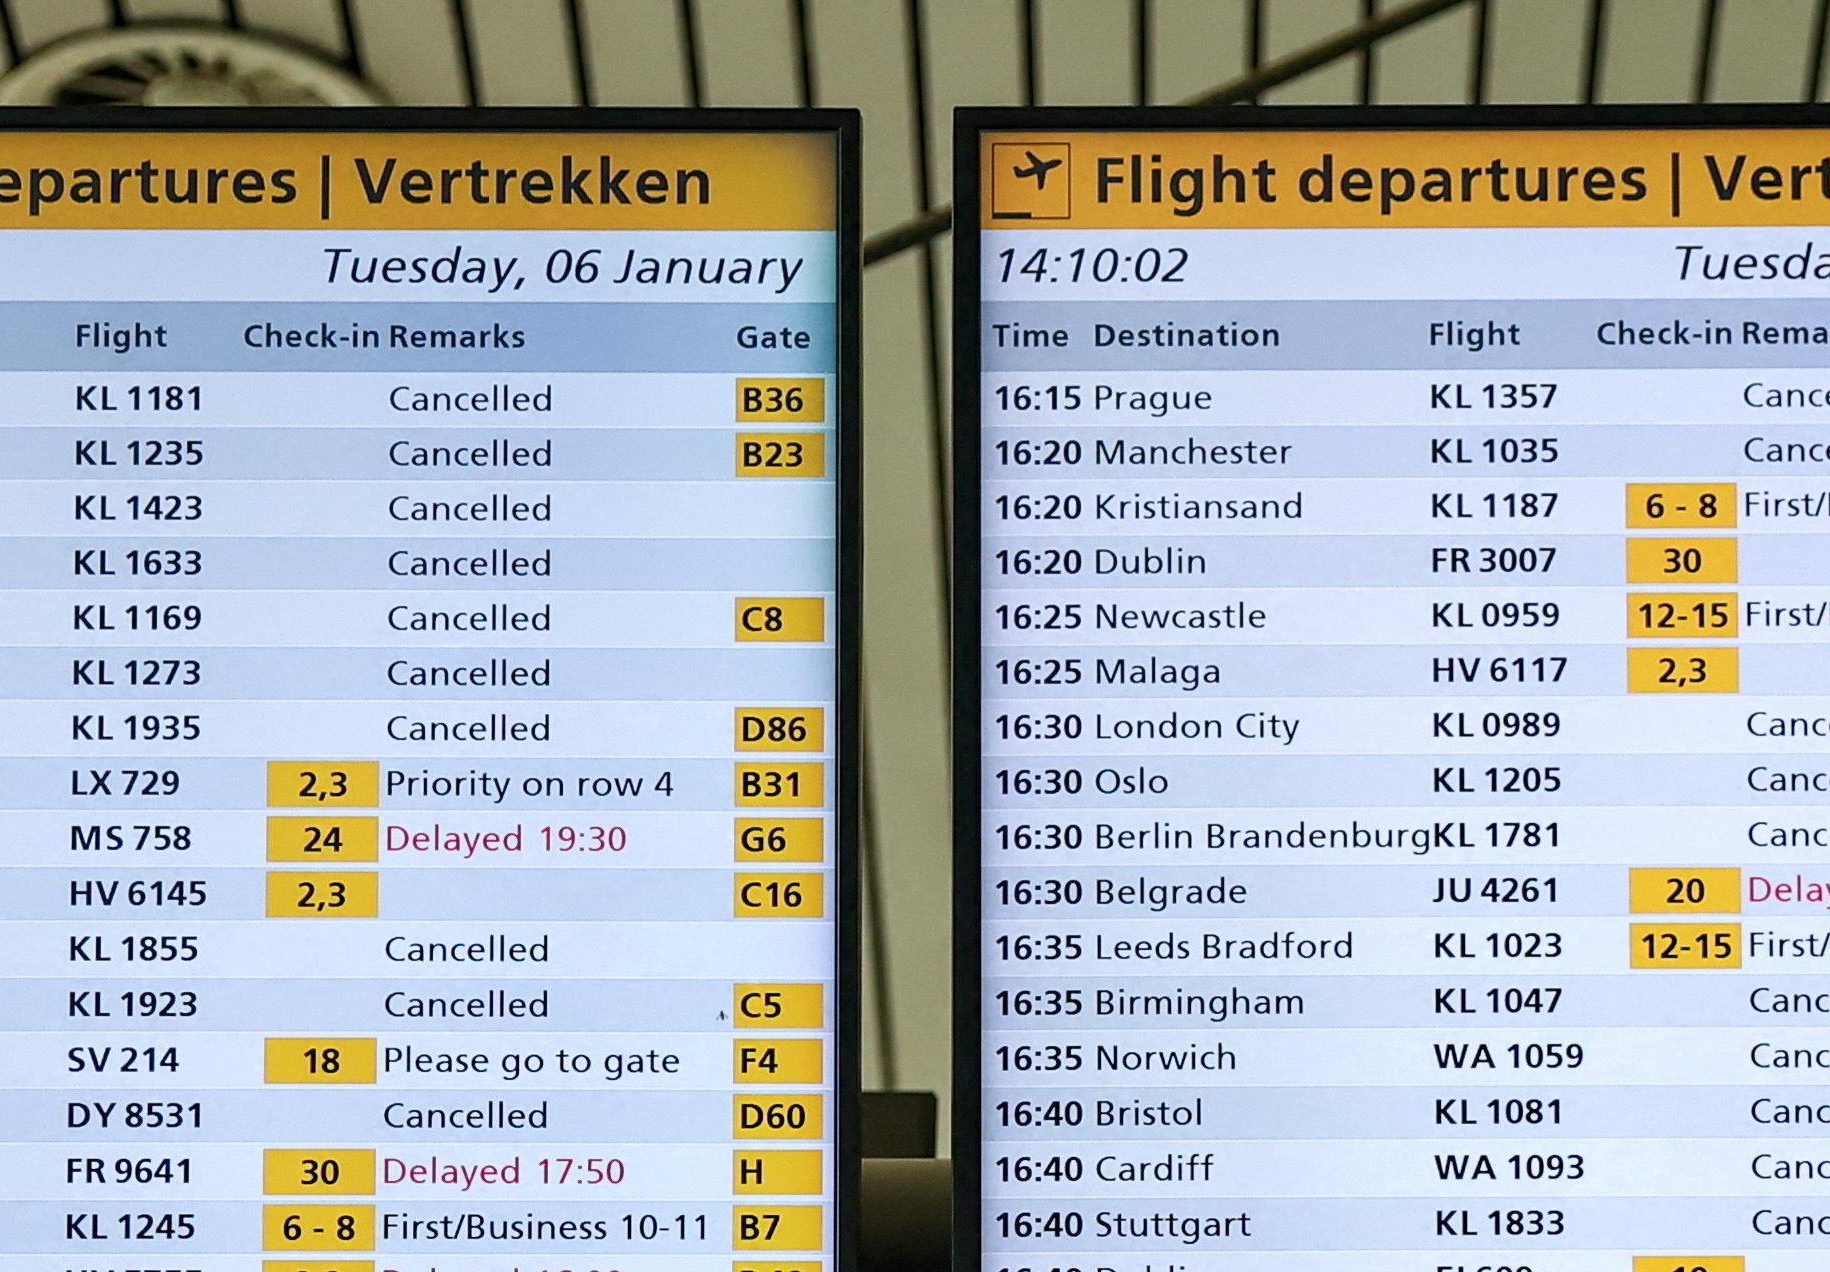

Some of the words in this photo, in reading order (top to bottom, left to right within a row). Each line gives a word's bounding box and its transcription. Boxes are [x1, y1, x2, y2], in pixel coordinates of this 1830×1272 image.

[352, 153, 711, 206] Vertrekken
[1096, 152, 1278, 219] Flight
[1297, 152, 1649, 217] departures
[322, 244, 527, 295] Tuesday,
[544, 247, 603, 286] 06
[611, 247, 805, 296] January
[998, 246, 1190, 284] 14:10:02
[75, 384, 119, 412] KL
[126, 384, 202, 412] 1181
[388, 382, 553, 413] Cancelled
[742, 385, 805, 415] B36
[994, 383, 1083, 412] 16:15
[1093, 383, 1213, 419] Prague
[1429, 382, 1474, 411] KL
[1480, 382, 1559, 410] 1357
[70, 768, 114, 797] LX
[119, 768, 181, 797] 729
[297, 770, 349, 803] 2,3
[385, 768, 512, 806] Priority
[521, 776, 566, 798] on
[577, 776, 645, 798] row
[652, 769, 675, 798] 4
[741, 770, 800, 799] B31
[66, 1045, 113, 1074] SV
[118, 1045, 181, 1074] 214
[302, 1046, 342, 1076] 18
[383, 1043, 491, 1074] Please
[500, 1052, 546, 1082] go
[554, 1048, 593, 1075] to
[602, 1048, 681, 1083] gate
[739, 1046, 780, 1075] F4
[994, 1043, 1084, 1073] 16:35
[1095, 1040, 1237, 1072] Norwich
[1432, 1042, 1497, 1071] WA
[1505, 1041, 1585, 1070] 1059
